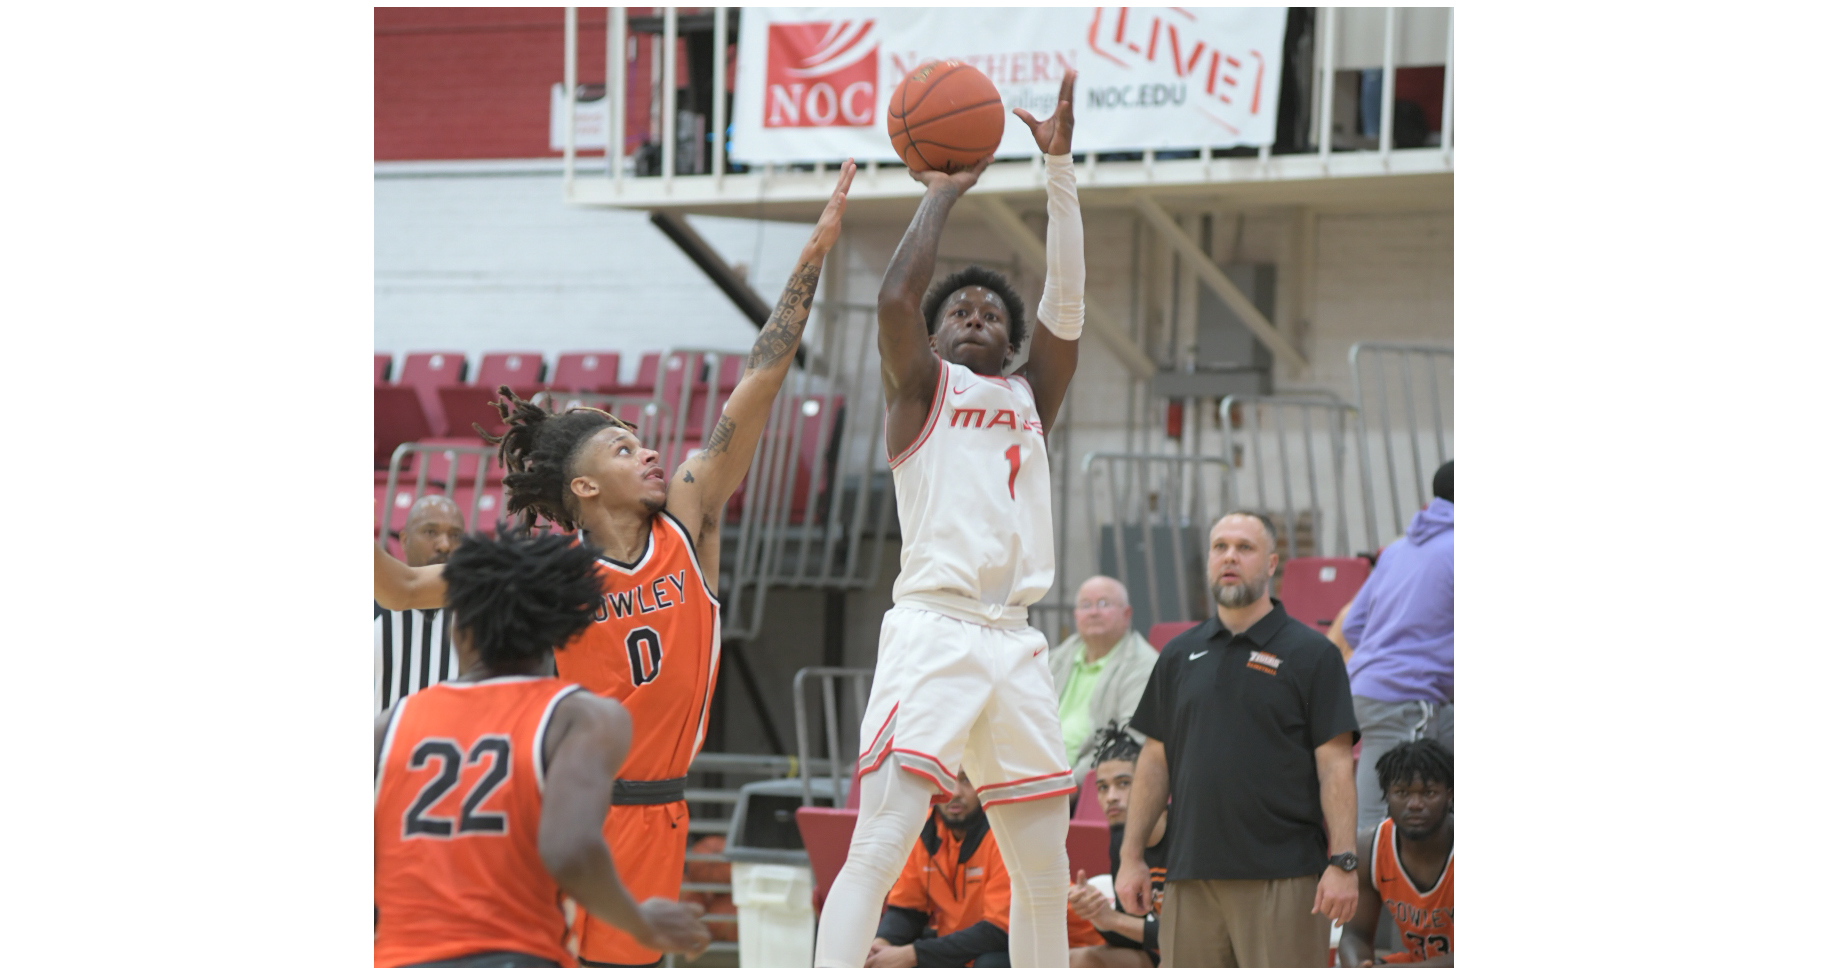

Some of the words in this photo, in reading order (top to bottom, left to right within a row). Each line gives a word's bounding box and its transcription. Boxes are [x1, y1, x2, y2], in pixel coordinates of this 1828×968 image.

[889, 50, 1077, 89] NTHERN
[1087, 83, 1188, 109] NOC.EDU
[768, 81, 874, 126] NOC
[1004, 444, 1021, 502] 1
[593, 569, 686, 624] OWLEY
[624, 625, 663, 688] 0
[401, 733, 514, 842] 22
